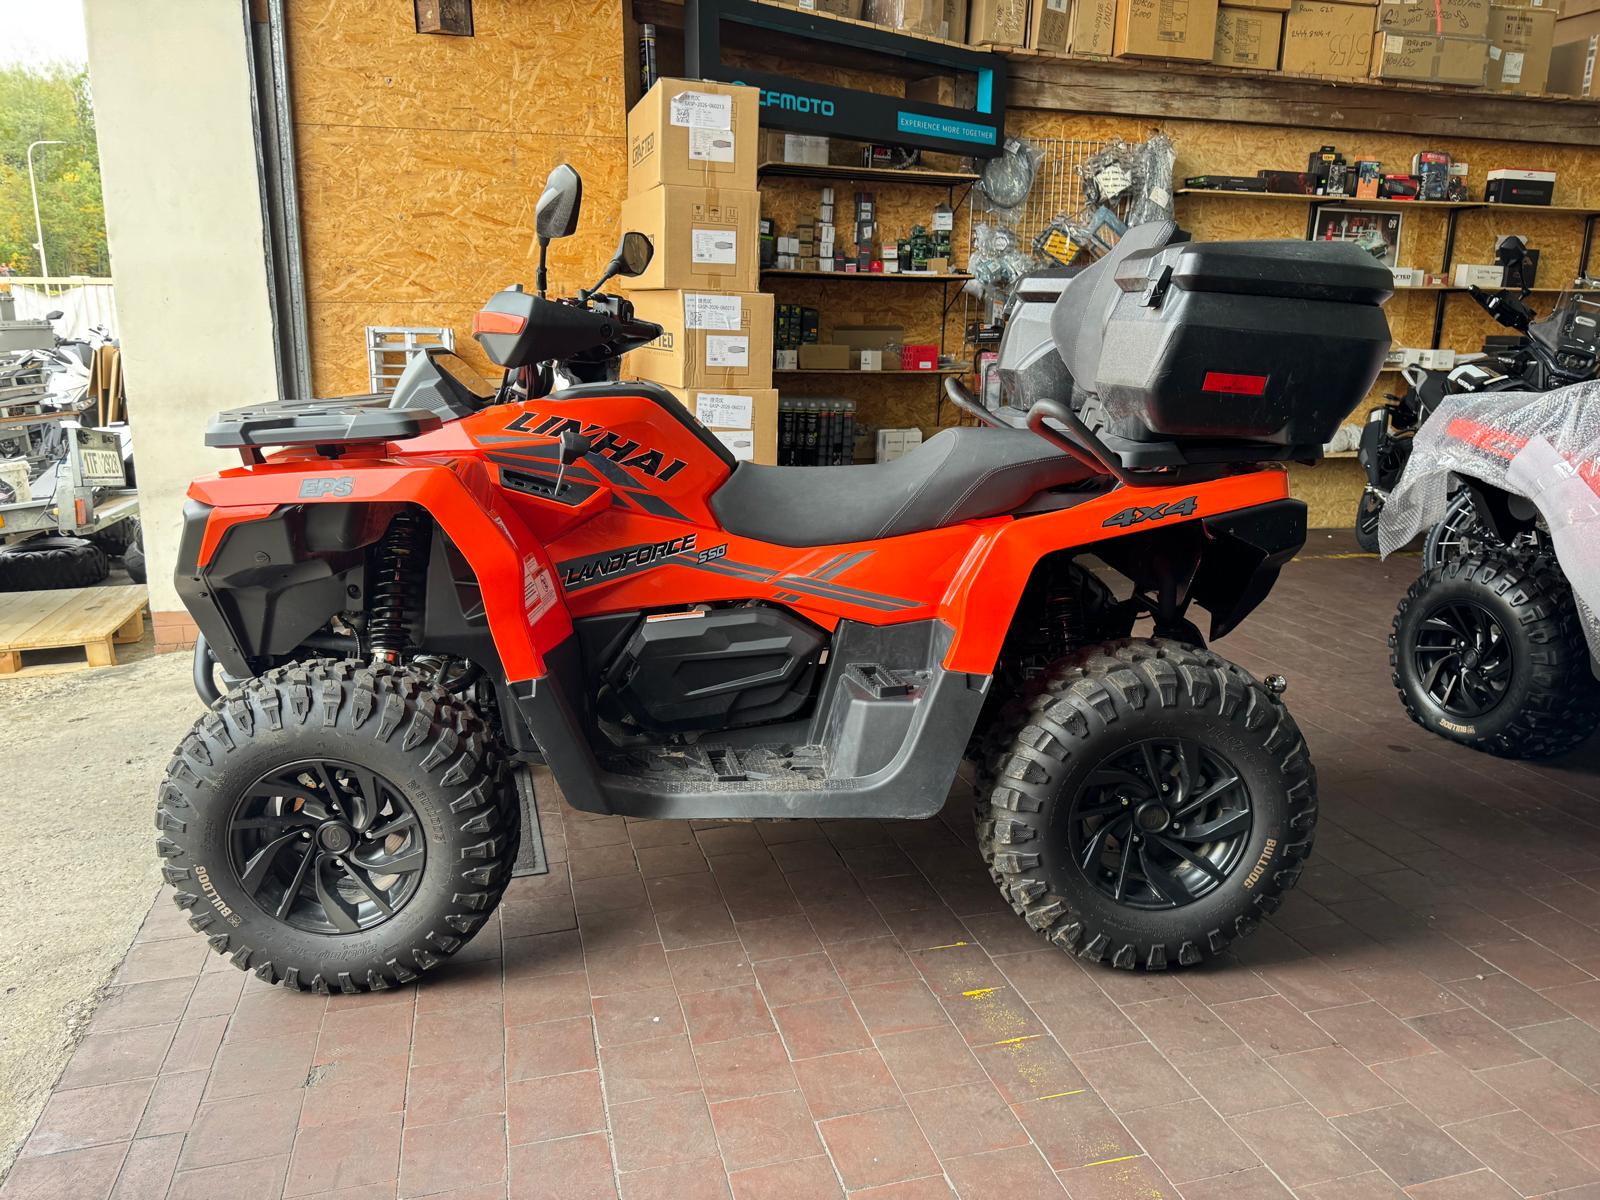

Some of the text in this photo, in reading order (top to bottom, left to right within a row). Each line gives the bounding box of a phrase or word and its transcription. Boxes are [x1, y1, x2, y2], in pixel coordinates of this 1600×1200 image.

[900, 118, 994, 140] EXPERIENCE MORE TOGETHER
[83, 452, 98, 474] 1TF
[502, 411, 688, 482] LINHAI
[298, 476, 356, 499] EPS
[564, 533, 697, 587] LANDFORCE
[1243, 838, 1277, 889] BULLDOG
[194, 864, 233, 918] BULLDOG
